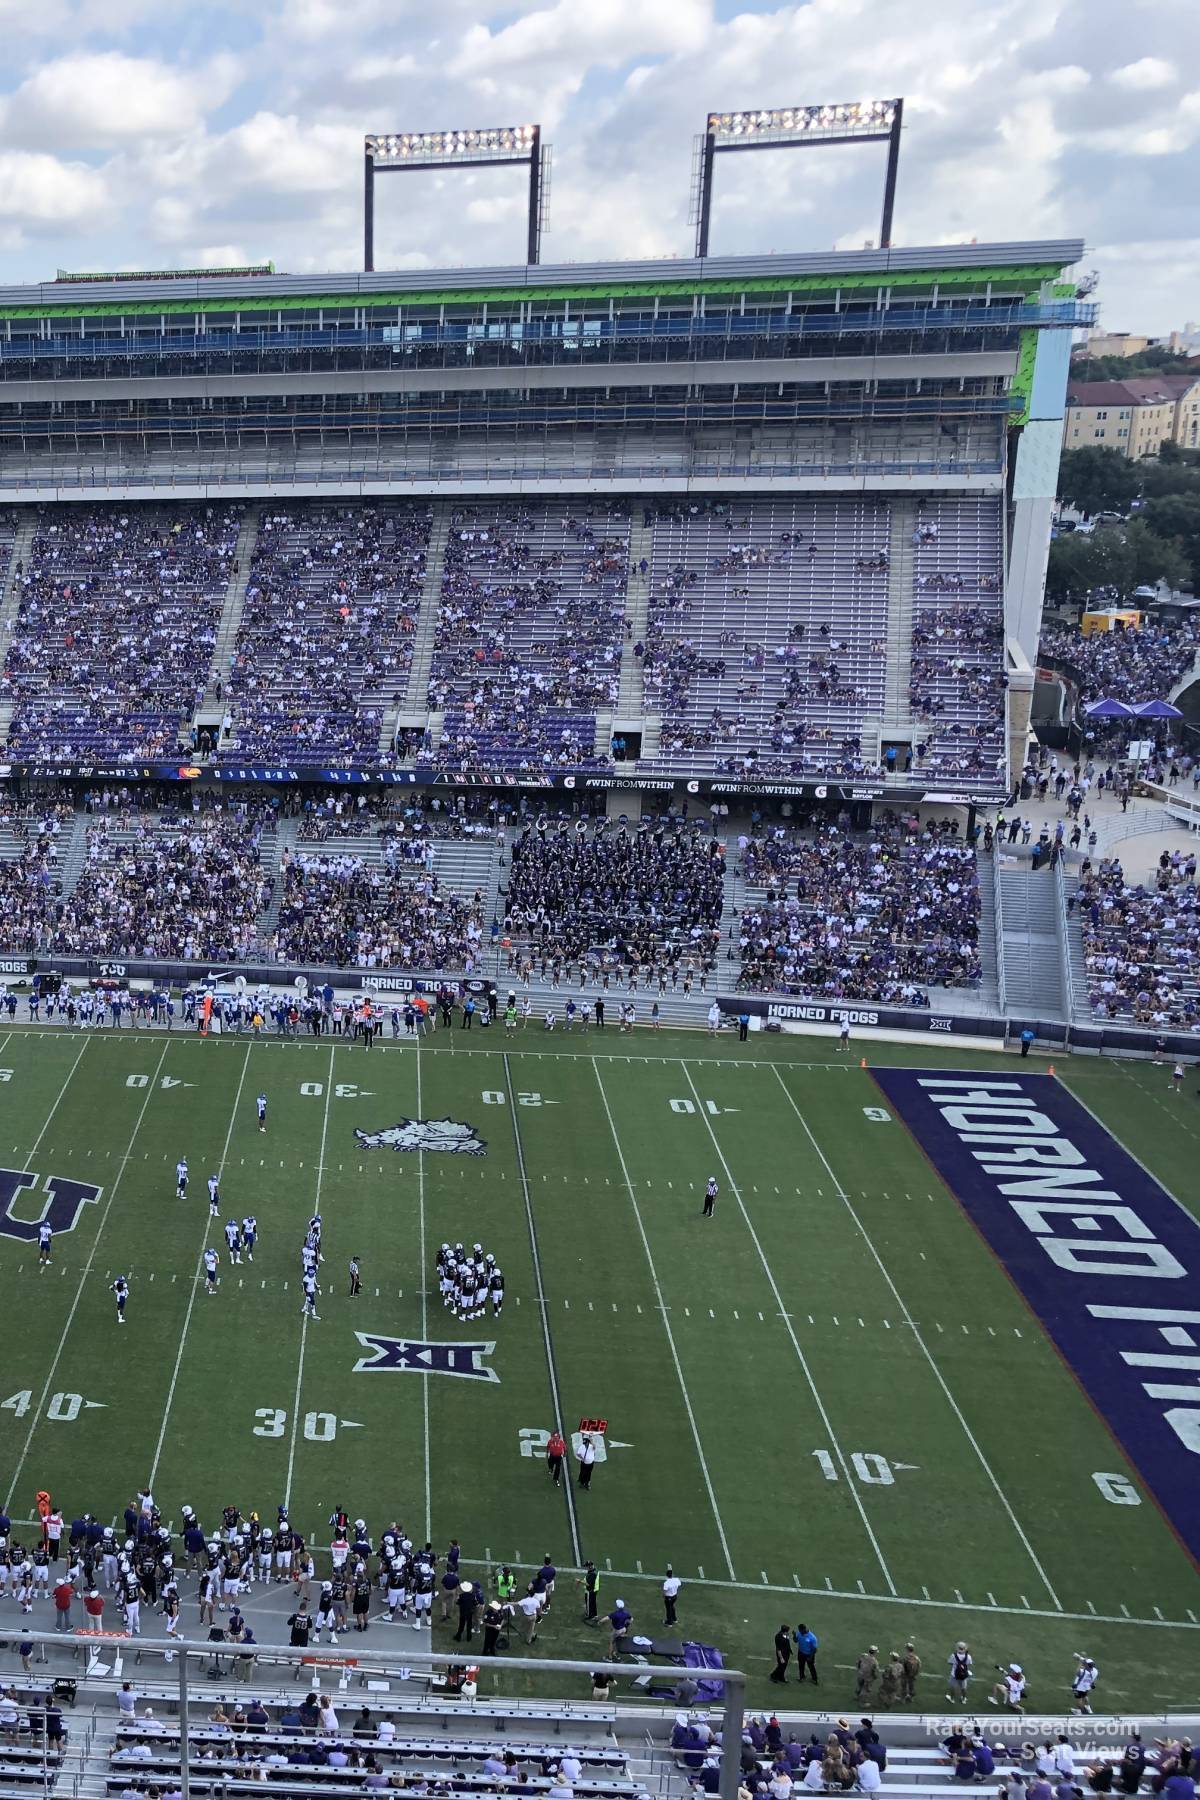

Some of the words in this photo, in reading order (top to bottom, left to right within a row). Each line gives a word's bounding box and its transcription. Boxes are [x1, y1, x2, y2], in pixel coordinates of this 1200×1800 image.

[563, 777, 576, 788] G
[585, 779, 675, 790] #WINFROMWITHIN
[687, 780, 699, 793] G
[710, 783, 804, 796] #WINFROMWITHIN
[815, 785, 828, 799] G
[767, 1004, 825, 1020] HORNED
[830, 1008, 879, 1025] FROGS
[916, 1078, 1189, 1279] HORNED
[0, 1389, 84, 1422] 40
[252, 1408, 338, 1442] 30
[812, 1449, 896, 1486] 10
[1091, 1471, 1143, 1506] G
